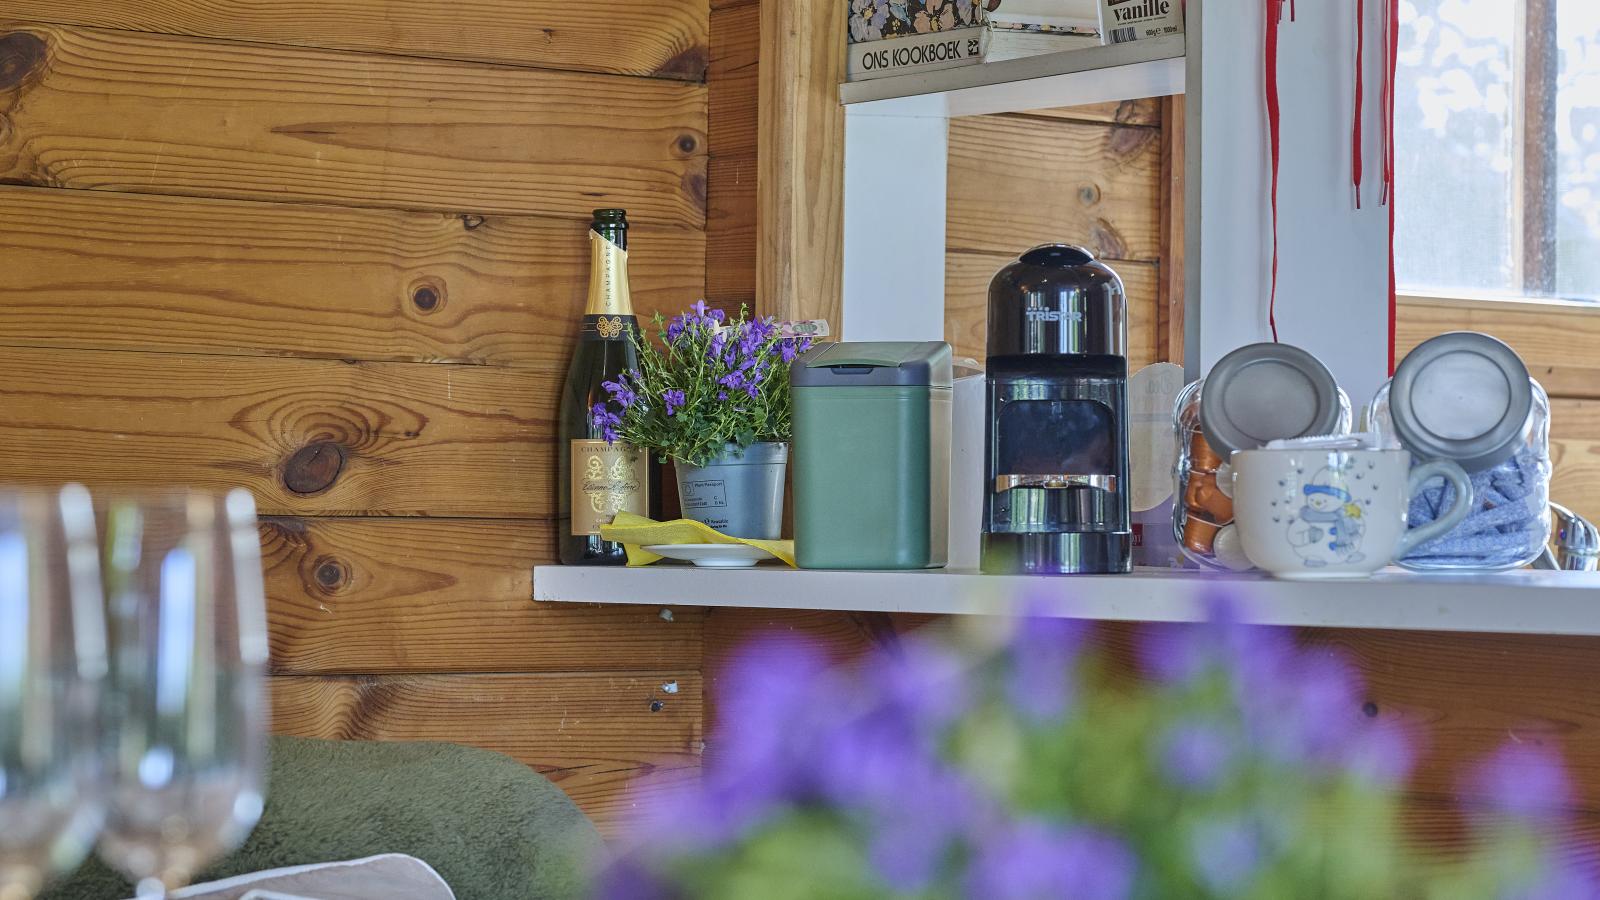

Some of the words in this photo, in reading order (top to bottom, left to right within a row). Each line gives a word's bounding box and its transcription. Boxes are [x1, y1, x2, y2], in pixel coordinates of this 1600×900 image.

[1112, 0, 1169, 21] vanille
[862, 50, 889, 70] ONS
[892, 40, 962, 67] KOOKBOEK
